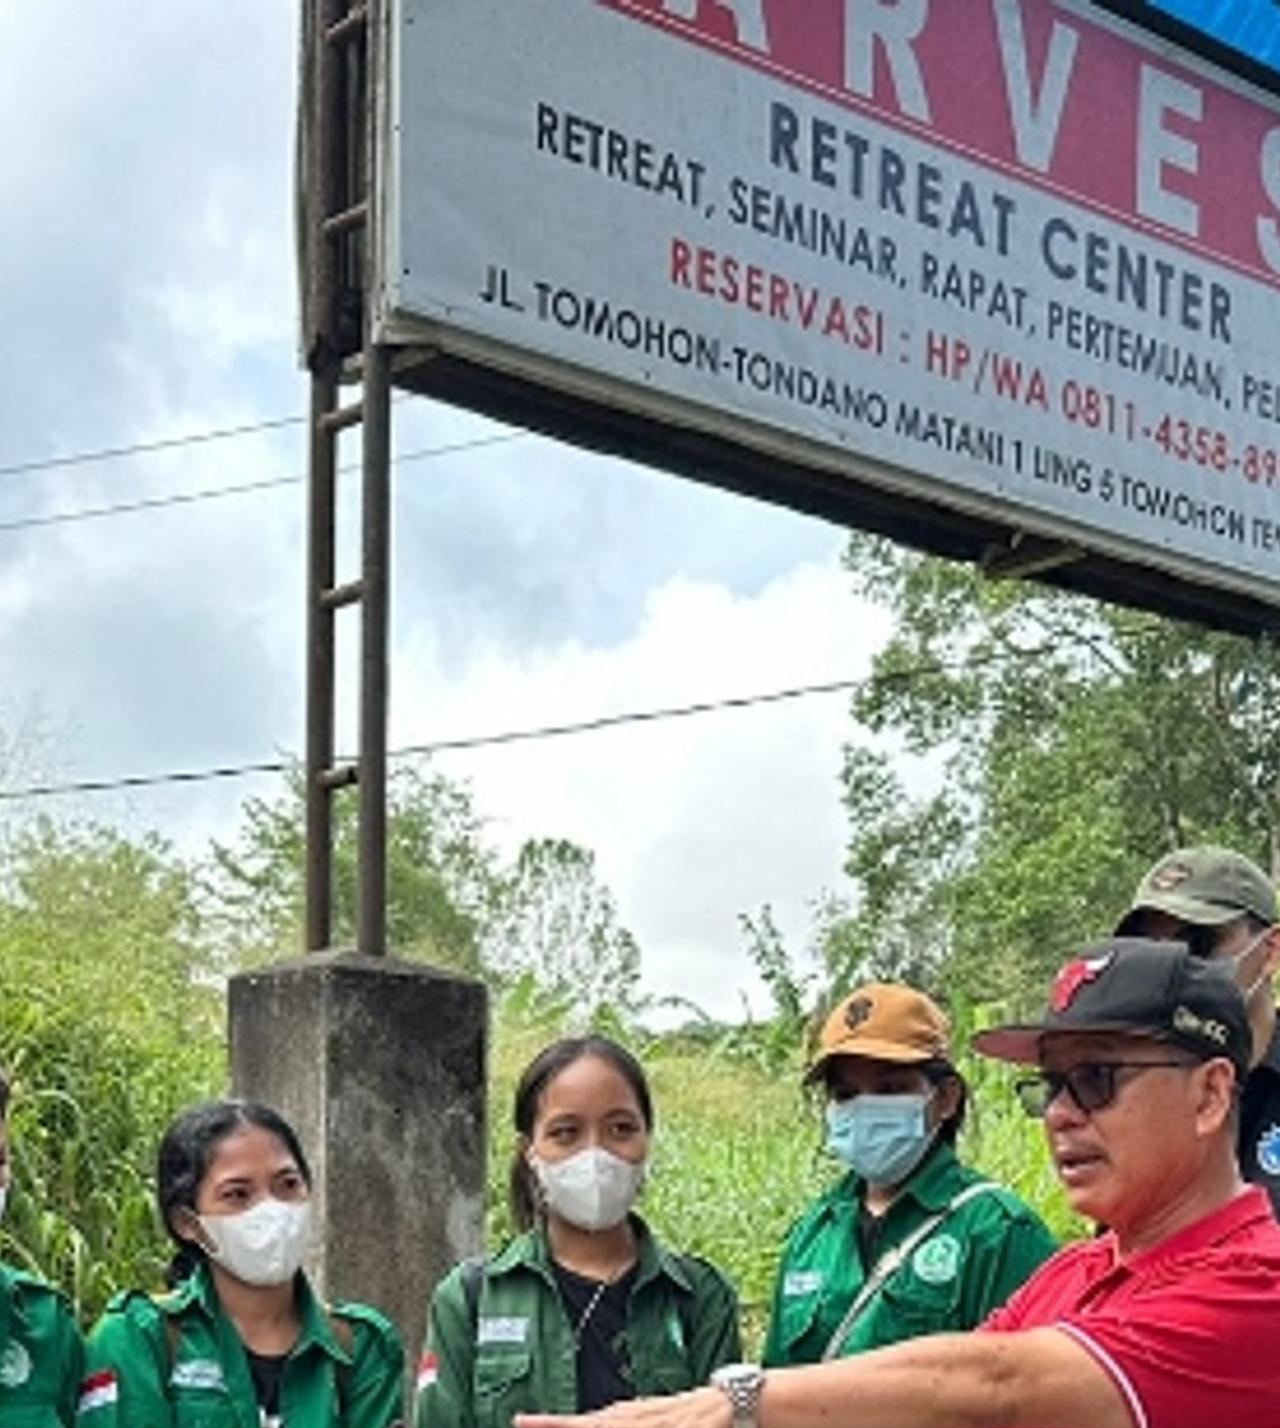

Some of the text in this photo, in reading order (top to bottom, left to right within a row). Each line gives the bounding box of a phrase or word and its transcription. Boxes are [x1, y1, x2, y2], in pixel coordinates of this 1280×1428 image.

[537, 101, 714, 219] RETREAT,
[728, 177, 907, 289] SEMINAR,
[922, 252, 1036, 336] RAPAT,
[1048, 301, 1231, 410] PERTEMUAN,
[671, 237, 883, 353] RESERVASI
[927, 330, 1049, 411] HP/WA
[770, 101, 1231, 344] RETREAT CENTER
[533, 281, 887, 428] TOMOHON-TONDANO
[895, 403, 1003, 465] MATANI
[1012, 441, 1023, 474] 1
[1034, 446, 1092, 493] LING
[1121, 477, 1246, 544] TOMOHON
